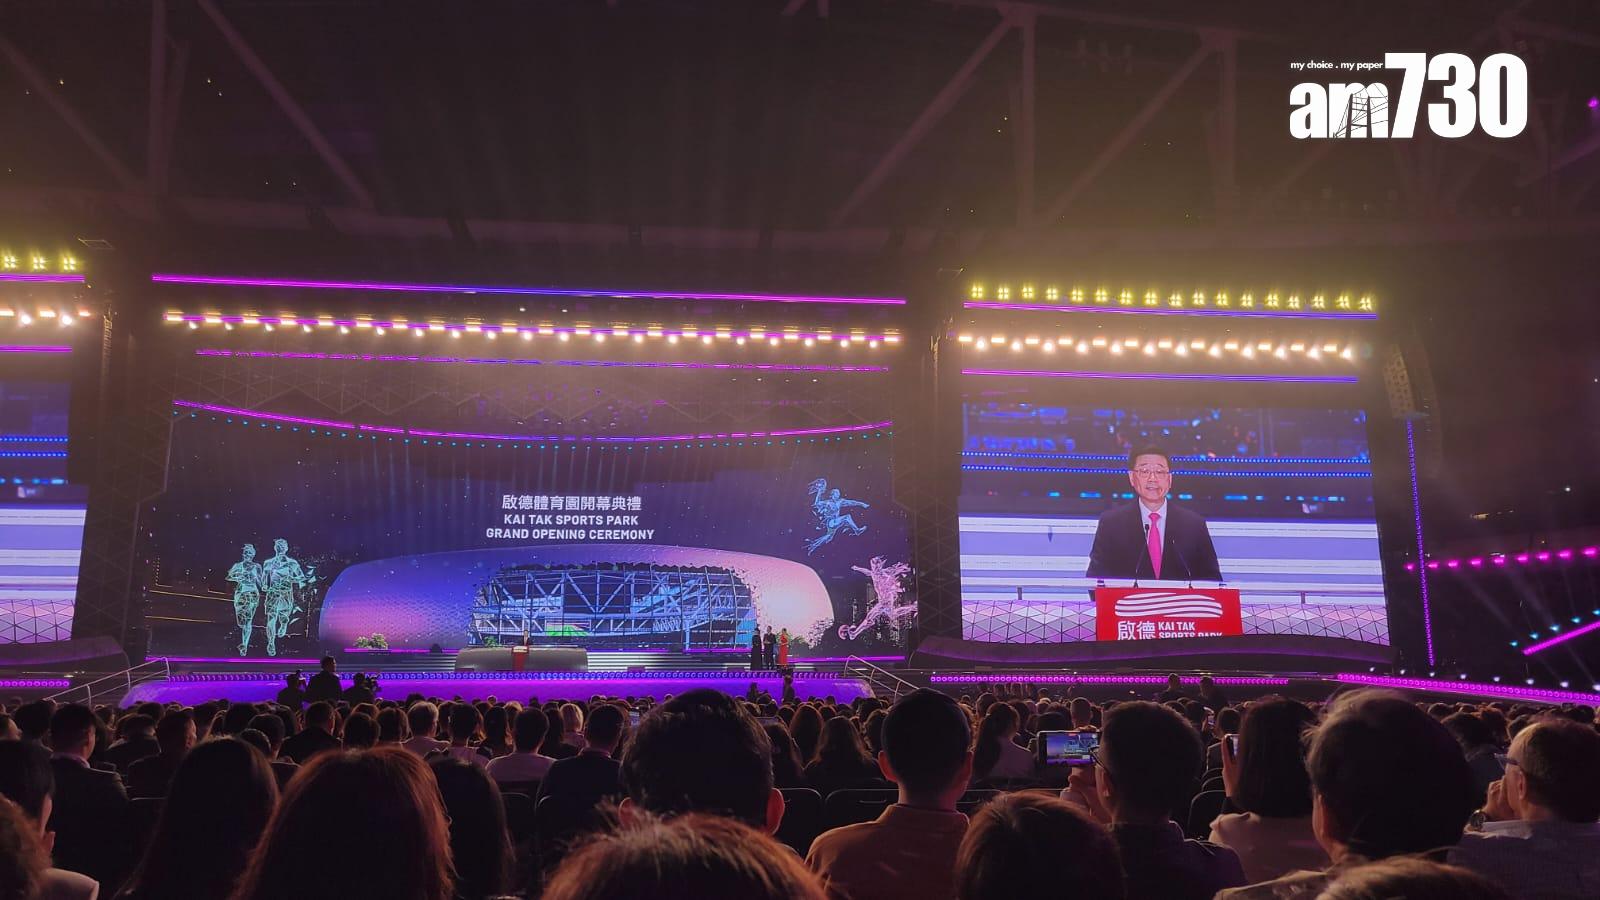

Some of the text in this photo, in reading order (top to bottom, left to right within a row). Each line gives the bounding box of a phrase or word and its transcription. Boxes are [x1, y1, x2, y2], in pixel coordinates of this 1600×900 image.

[504, 514, 639, 525] KAI TAK SPORTS PARK
[486, 528, 655, 540] GRAND OPENING CEREMONY
[1158, 622, 1195, 631] KAI TAK
